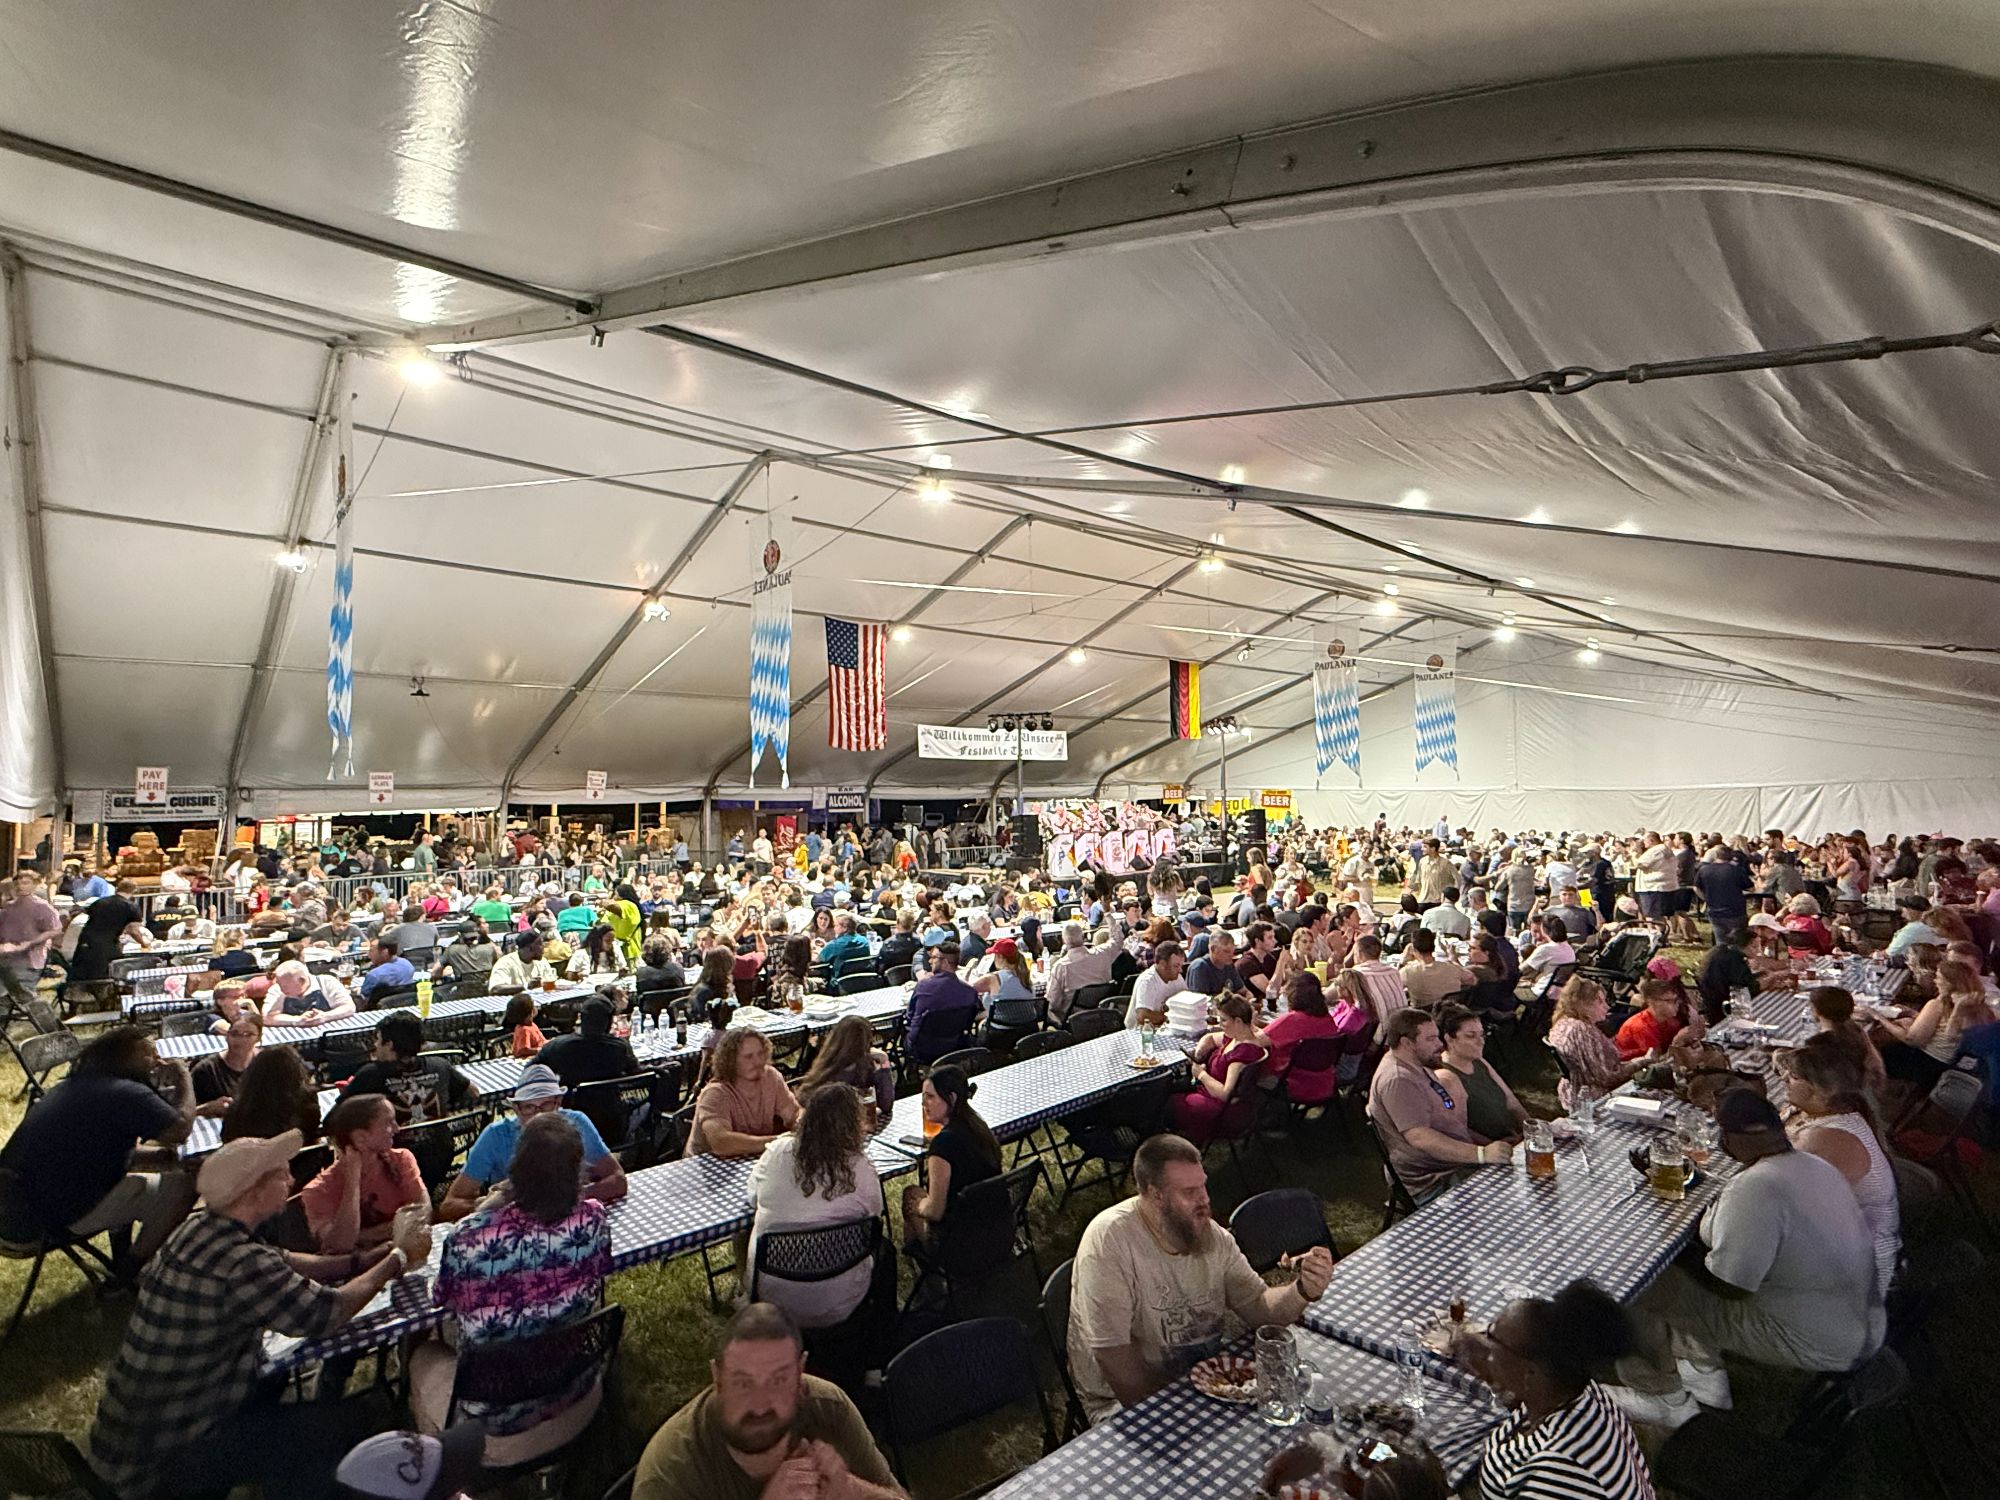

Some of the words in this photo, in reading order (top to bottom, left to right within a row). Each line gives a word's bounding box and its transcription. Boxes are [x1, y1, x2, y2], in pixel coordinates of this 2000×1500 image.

[1314, 659, 1357, 671] PAULANER
[933, 729, 1001, 742] Willkommen
[142, 770, 162, 779] PAY
[138, 782, 165, 791] HERE
[1164, 789, 1183, 799] BEER
[828, 795, 864, 807] ALCOHOL
[1263, 795, 1290, 806] BEER
